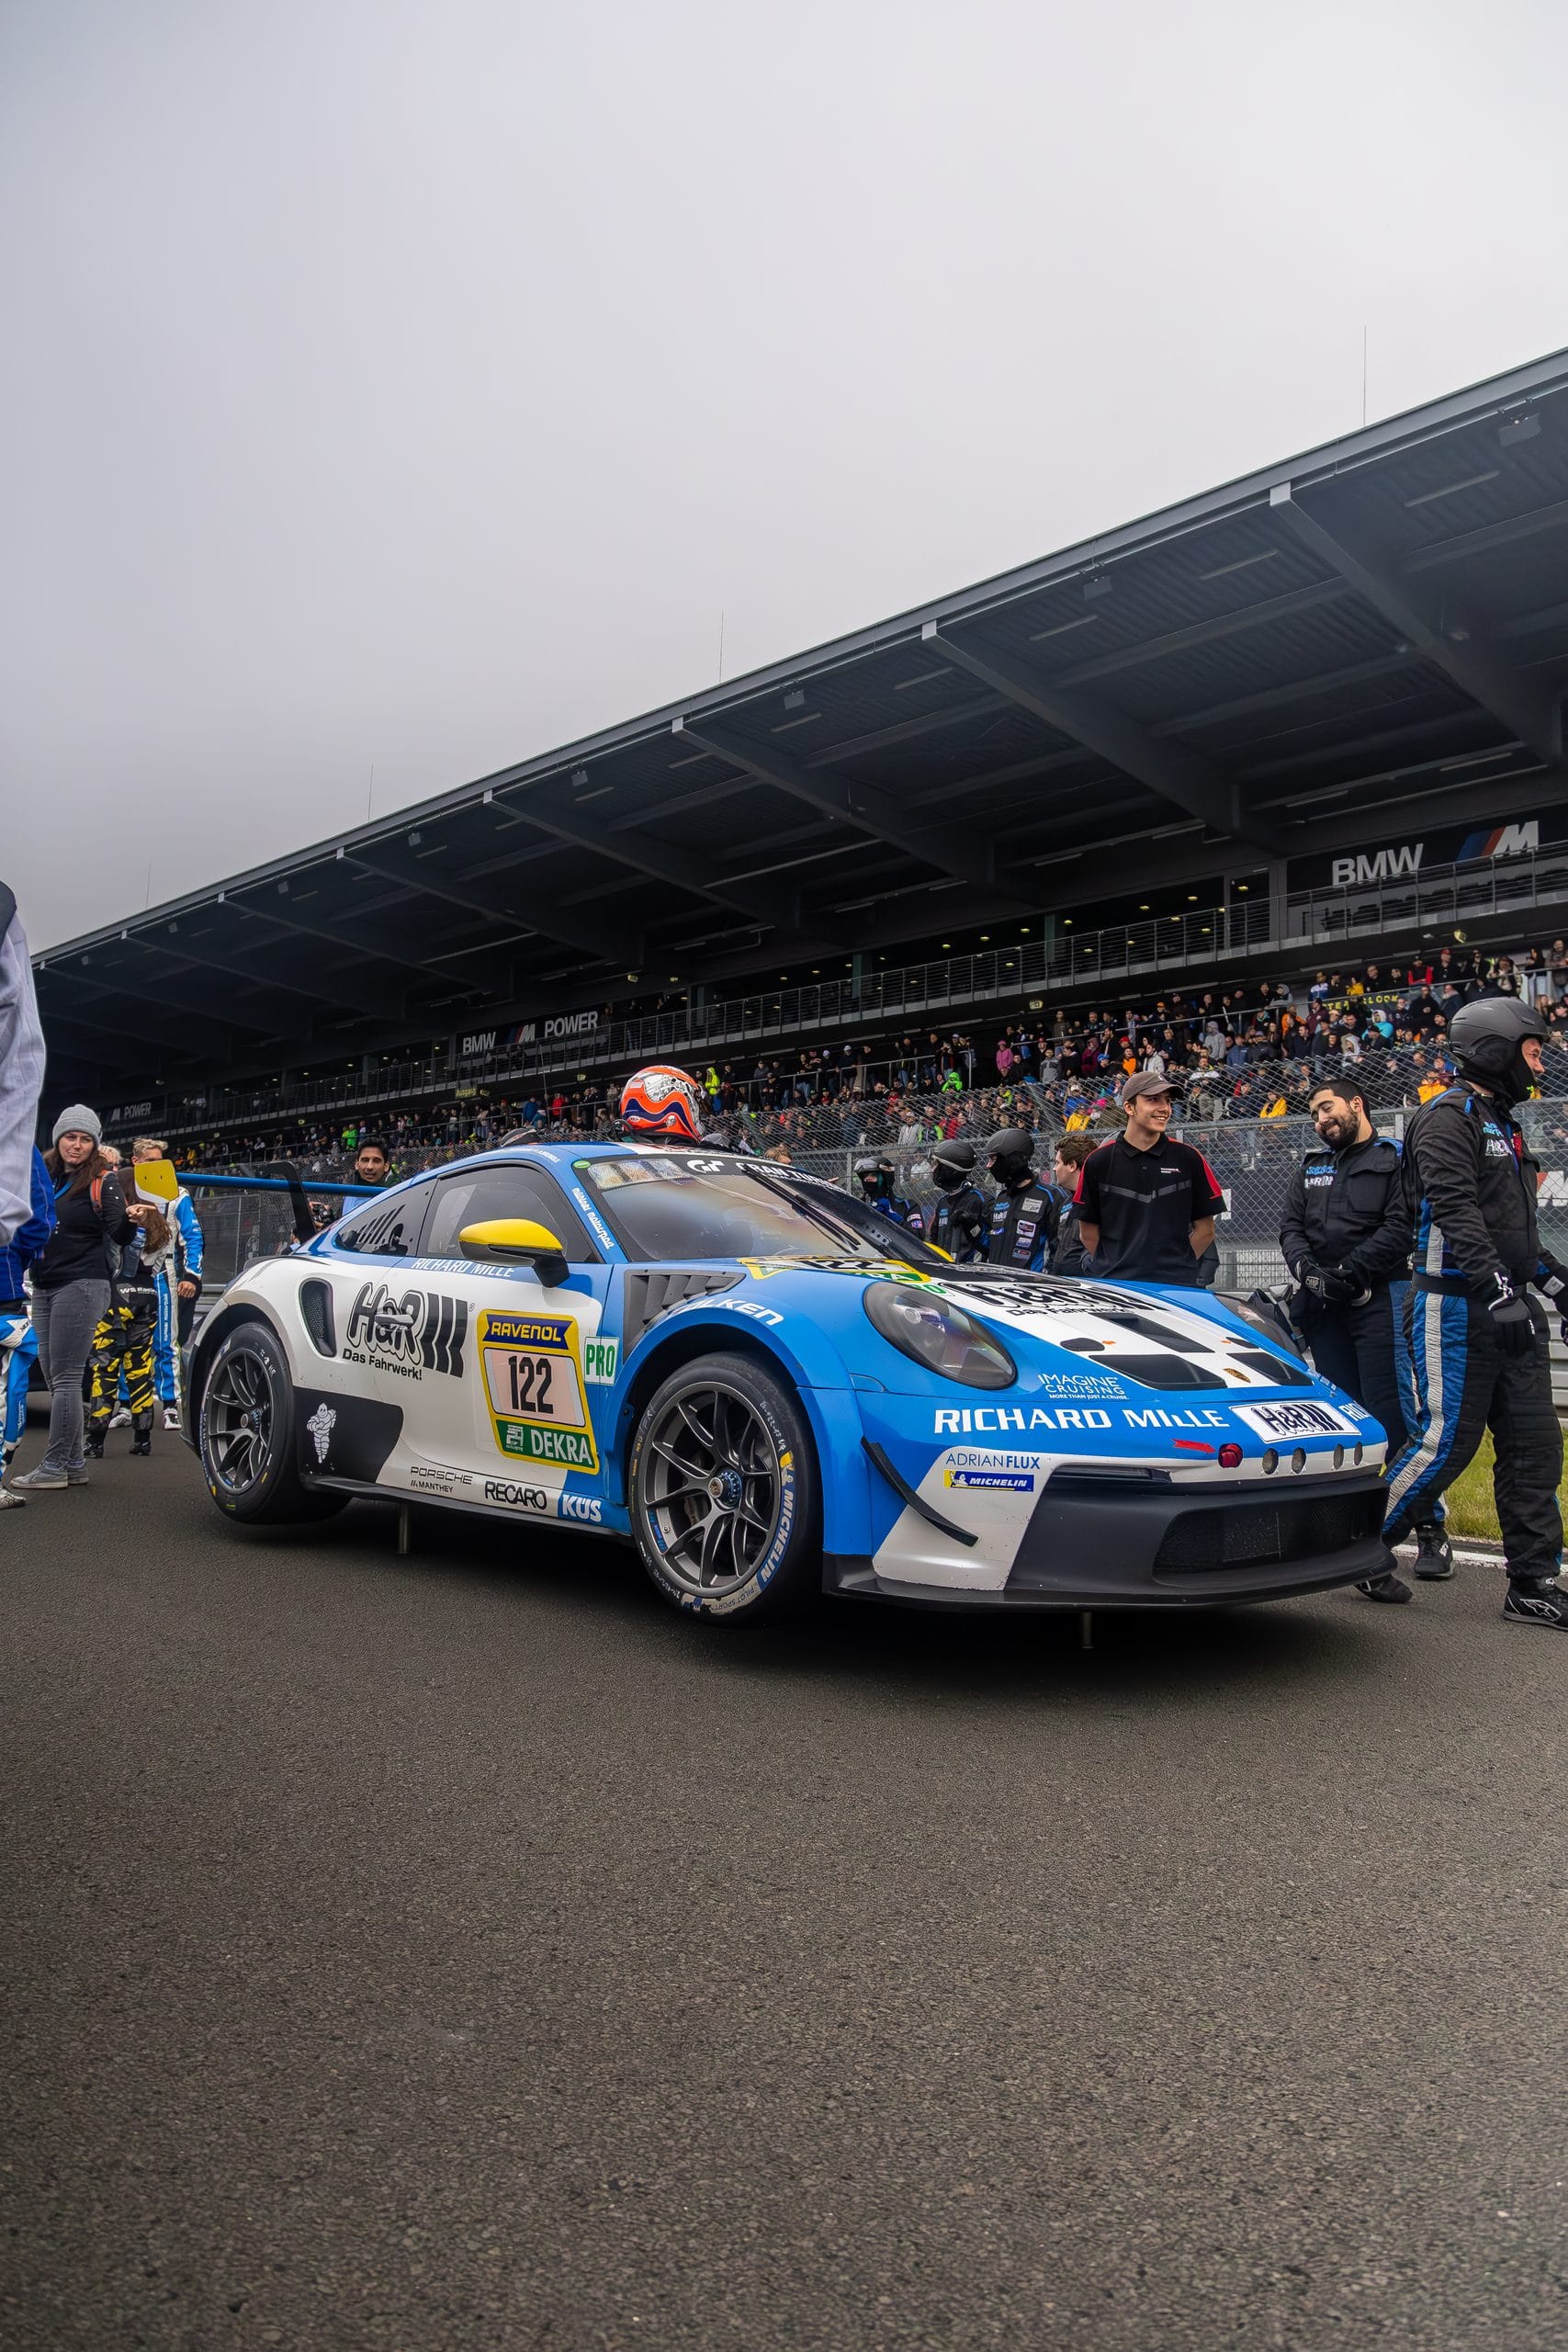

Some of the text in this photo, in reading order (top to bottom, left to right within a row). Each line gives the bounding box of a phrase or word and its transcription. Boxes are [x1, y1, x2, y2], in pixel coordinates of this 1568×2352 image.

[1331, 842, 1424, 887] BMW
[462, 1032, 497, 1056] BMW
[545, 1011, 598, 1039] POWER
[124, 1102, 152, 1120] POWER
[587, 1211, 615, 1250] motorsport
[412, 1258, 514, 1278] RICHARD MILLE
[491, 1321, 561, 1342] RAVENOL
[343, 1348, 423, 1381] Das Fahrwerk!
[585, 1344, 615, 1378] PRO
[508, 1355, 554, 1414] 122
[1038, 1374, 1119, 1387] IMAGINE
[1045, 1385, 1125, 1395] CRUISING
[933, 1408, 1230, 1434] RICHARD MILLE
[530, 1429, 592, 1465] DEKRA
[411, 1466, 473, 1486] PORSCHE
[419, 1480, 454, 1493] MANTHEY
[969, 1477, 1028, 1487] MICHELIN
[484, 1480, 547, 1510] RECARO
[562, 1494, 602, 1522] KÜS
[761, 1488, 795, 1584] MICHELIN
